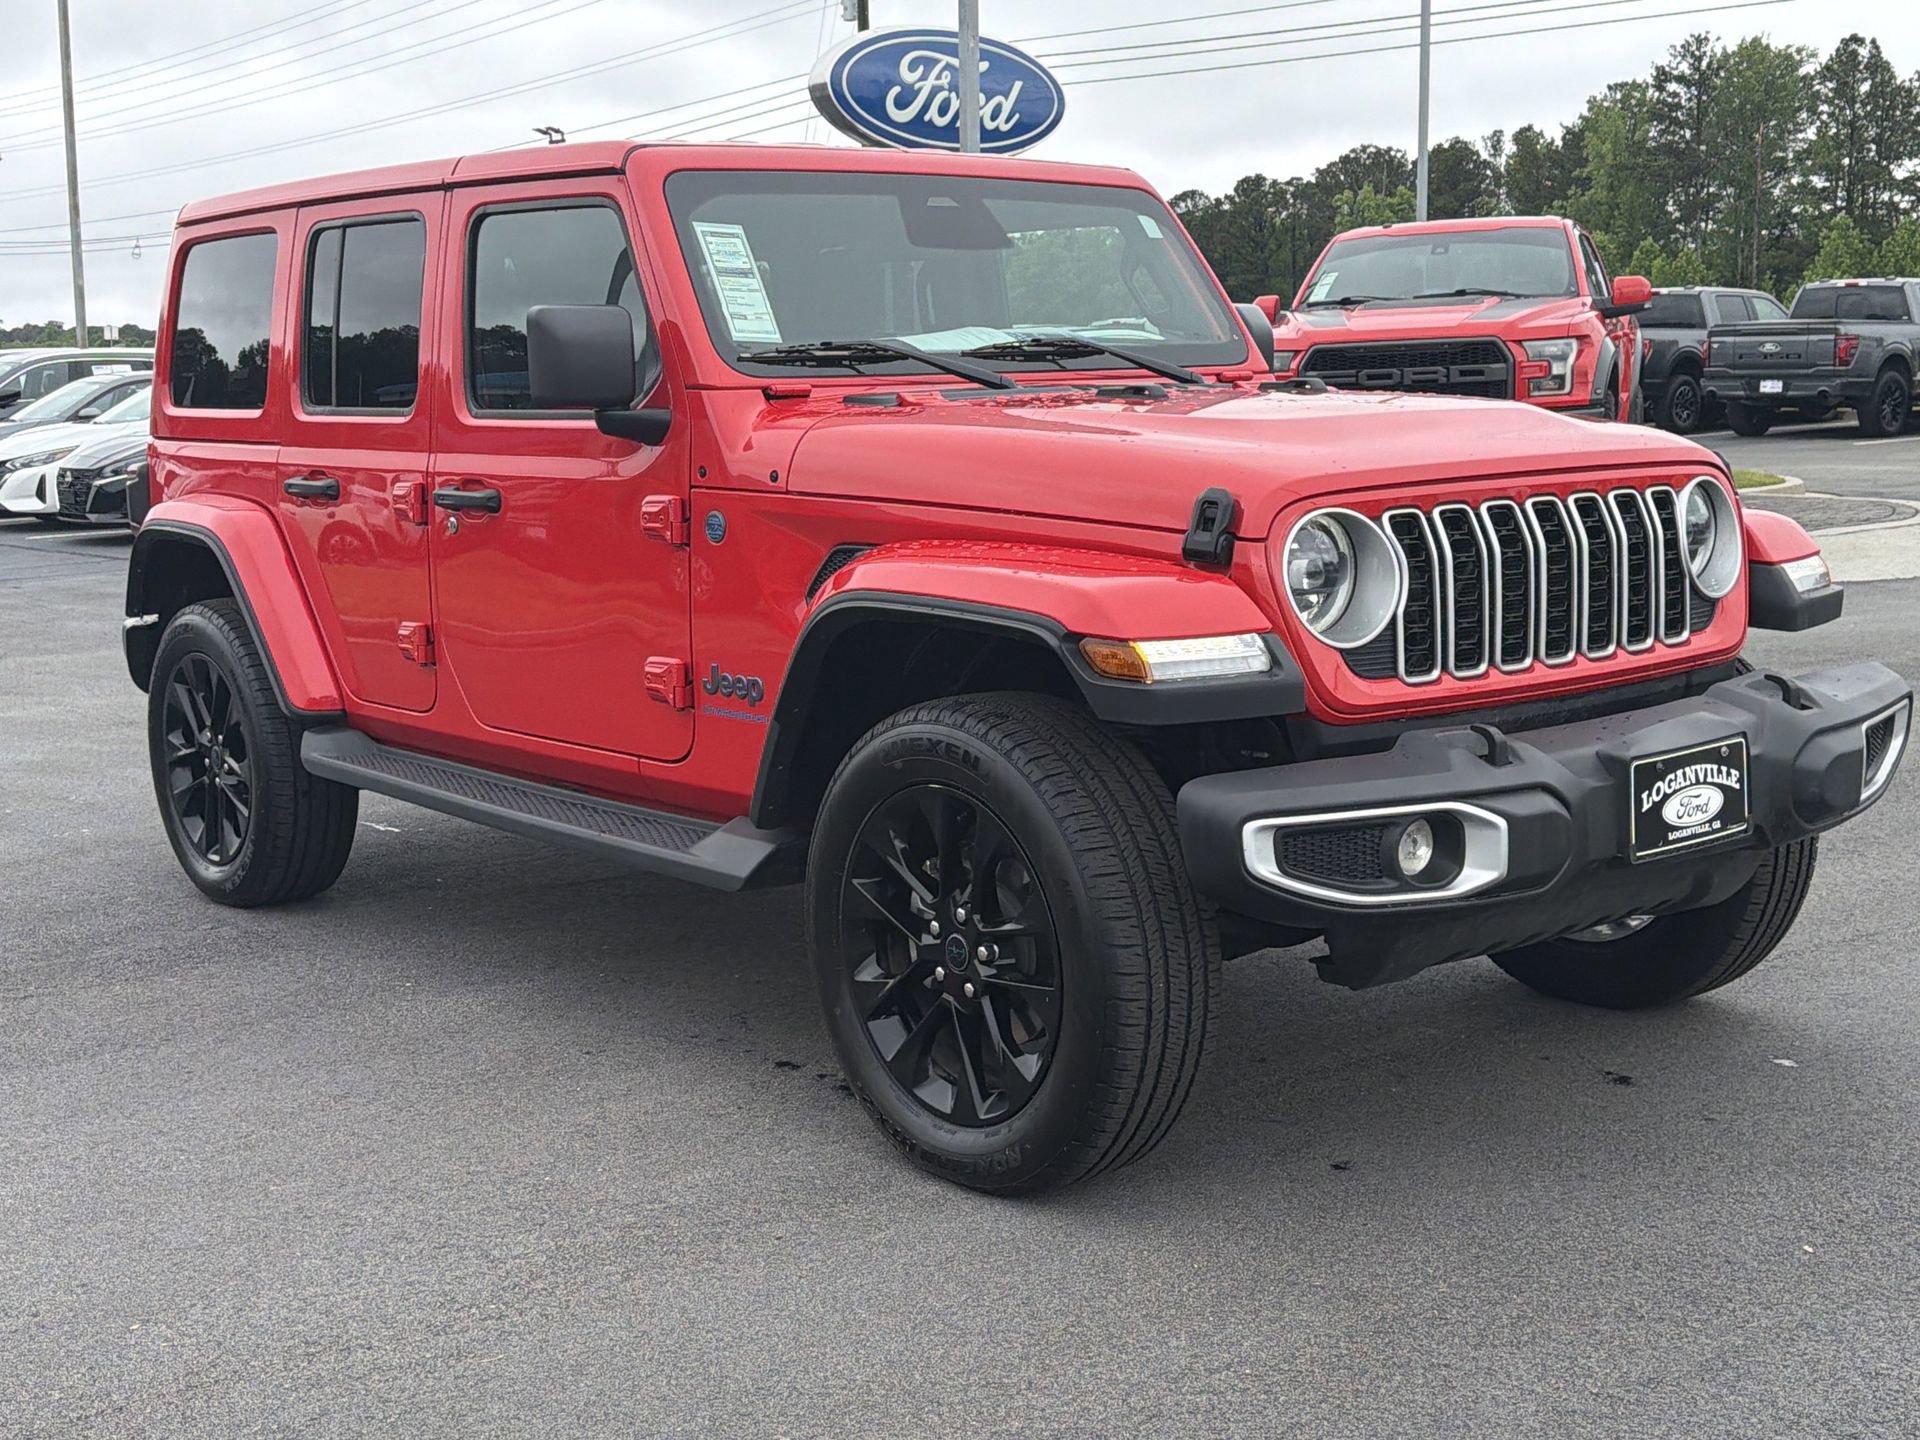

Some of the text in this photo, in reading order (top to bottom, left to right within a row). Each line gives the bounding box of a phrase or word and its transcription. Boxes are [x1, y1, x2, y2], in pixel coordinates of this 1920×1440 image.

[702, 664, 764, 707] Jeep
[889, 737, 981, 771] NEXEN
[1641, 763, 1740, 813] LOGANVILLE
[1676, 793, 1712, 820] Ford
